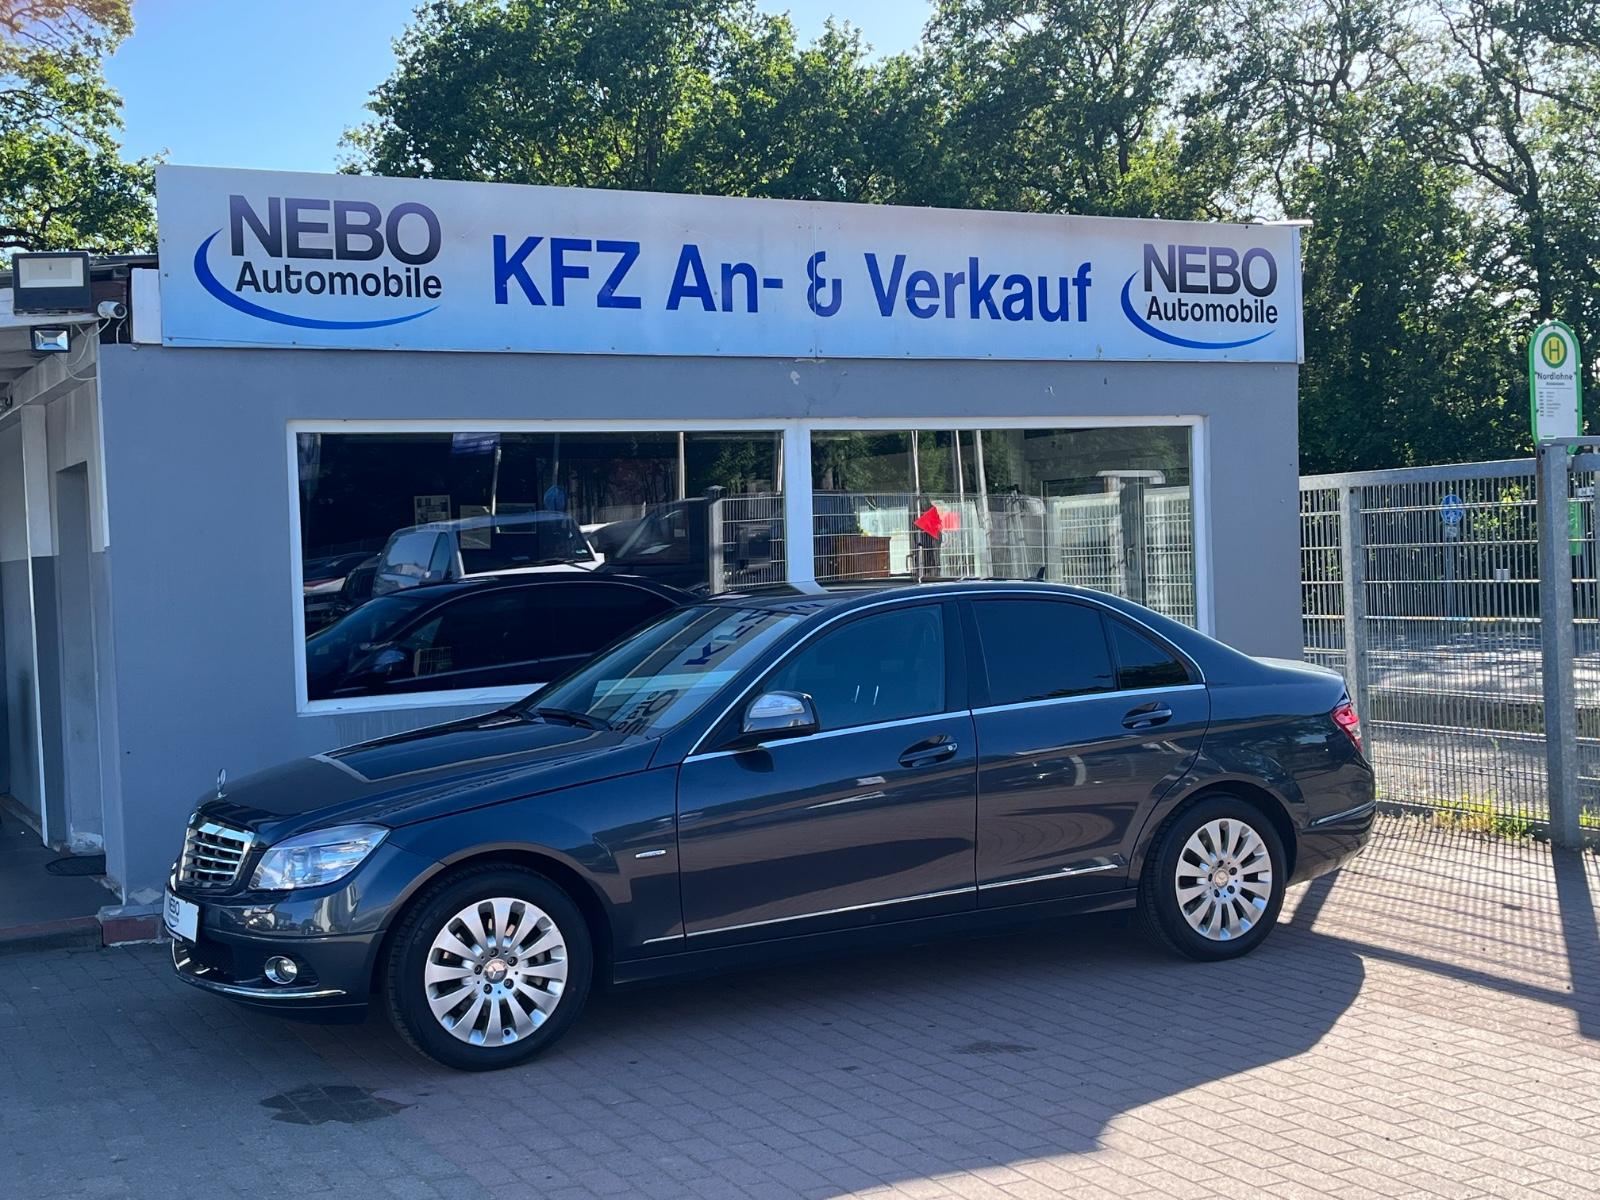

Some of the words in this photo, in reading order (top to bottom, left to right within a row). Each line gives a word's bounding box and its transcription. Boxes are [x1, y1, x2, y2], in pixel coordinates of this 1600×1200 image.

[229, 195, 442, 265] NEBO
[236, 260, 442, 299] Automobile
[493, 235, 641, 309] KFZ
[666, 245, 784, 313] An-
[807, 251, 843, 318] &
[864, 253, 1092, 323] Verkauf
[1143, 244, 1278, 297] NEBO
[1146, 295, 1278, 325] Automobile
[1549, 340, 1560, 361] H
[1537, 372, 1574, 381] Nordlohne
